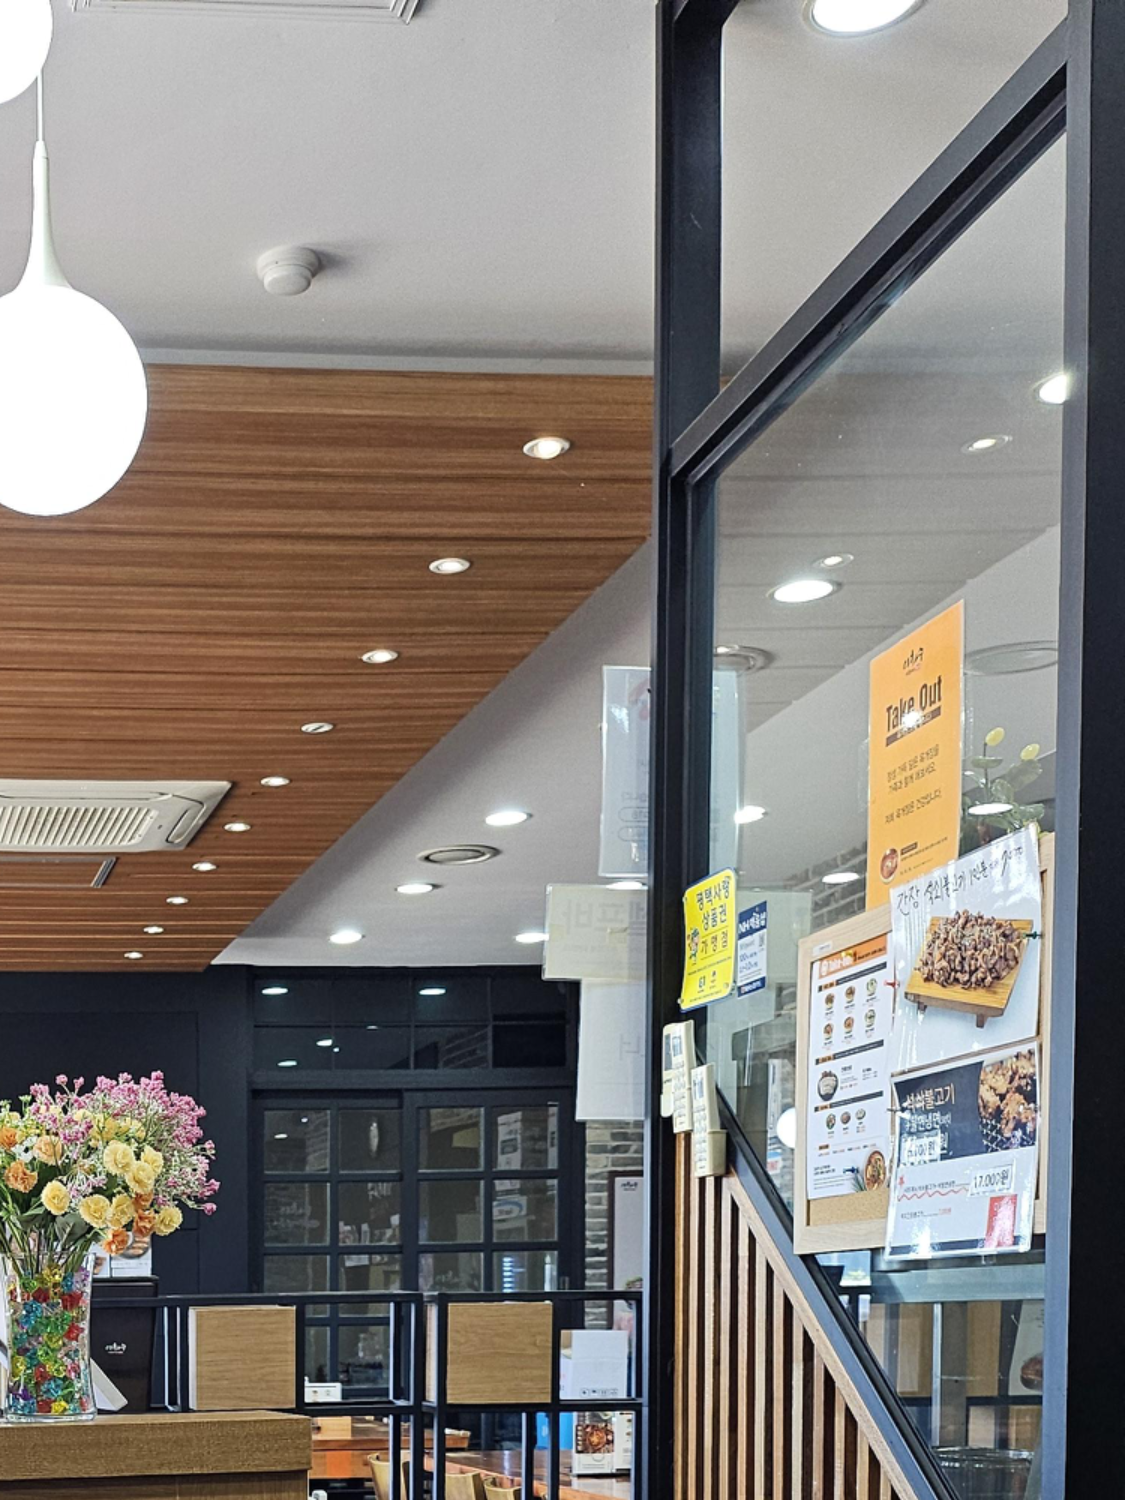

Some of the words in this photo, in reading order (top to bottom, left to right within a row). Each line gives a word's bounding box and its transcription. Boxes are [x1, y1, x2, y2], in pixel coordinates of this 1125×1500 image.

[886, 696, 915, 732] Take
[919, 675, 942, 711] Out
[696, 876, 731, 911] 평택사랑
[702, 903, 728, 931] 상품권
[702, 930, 729, 956] 가맹점
